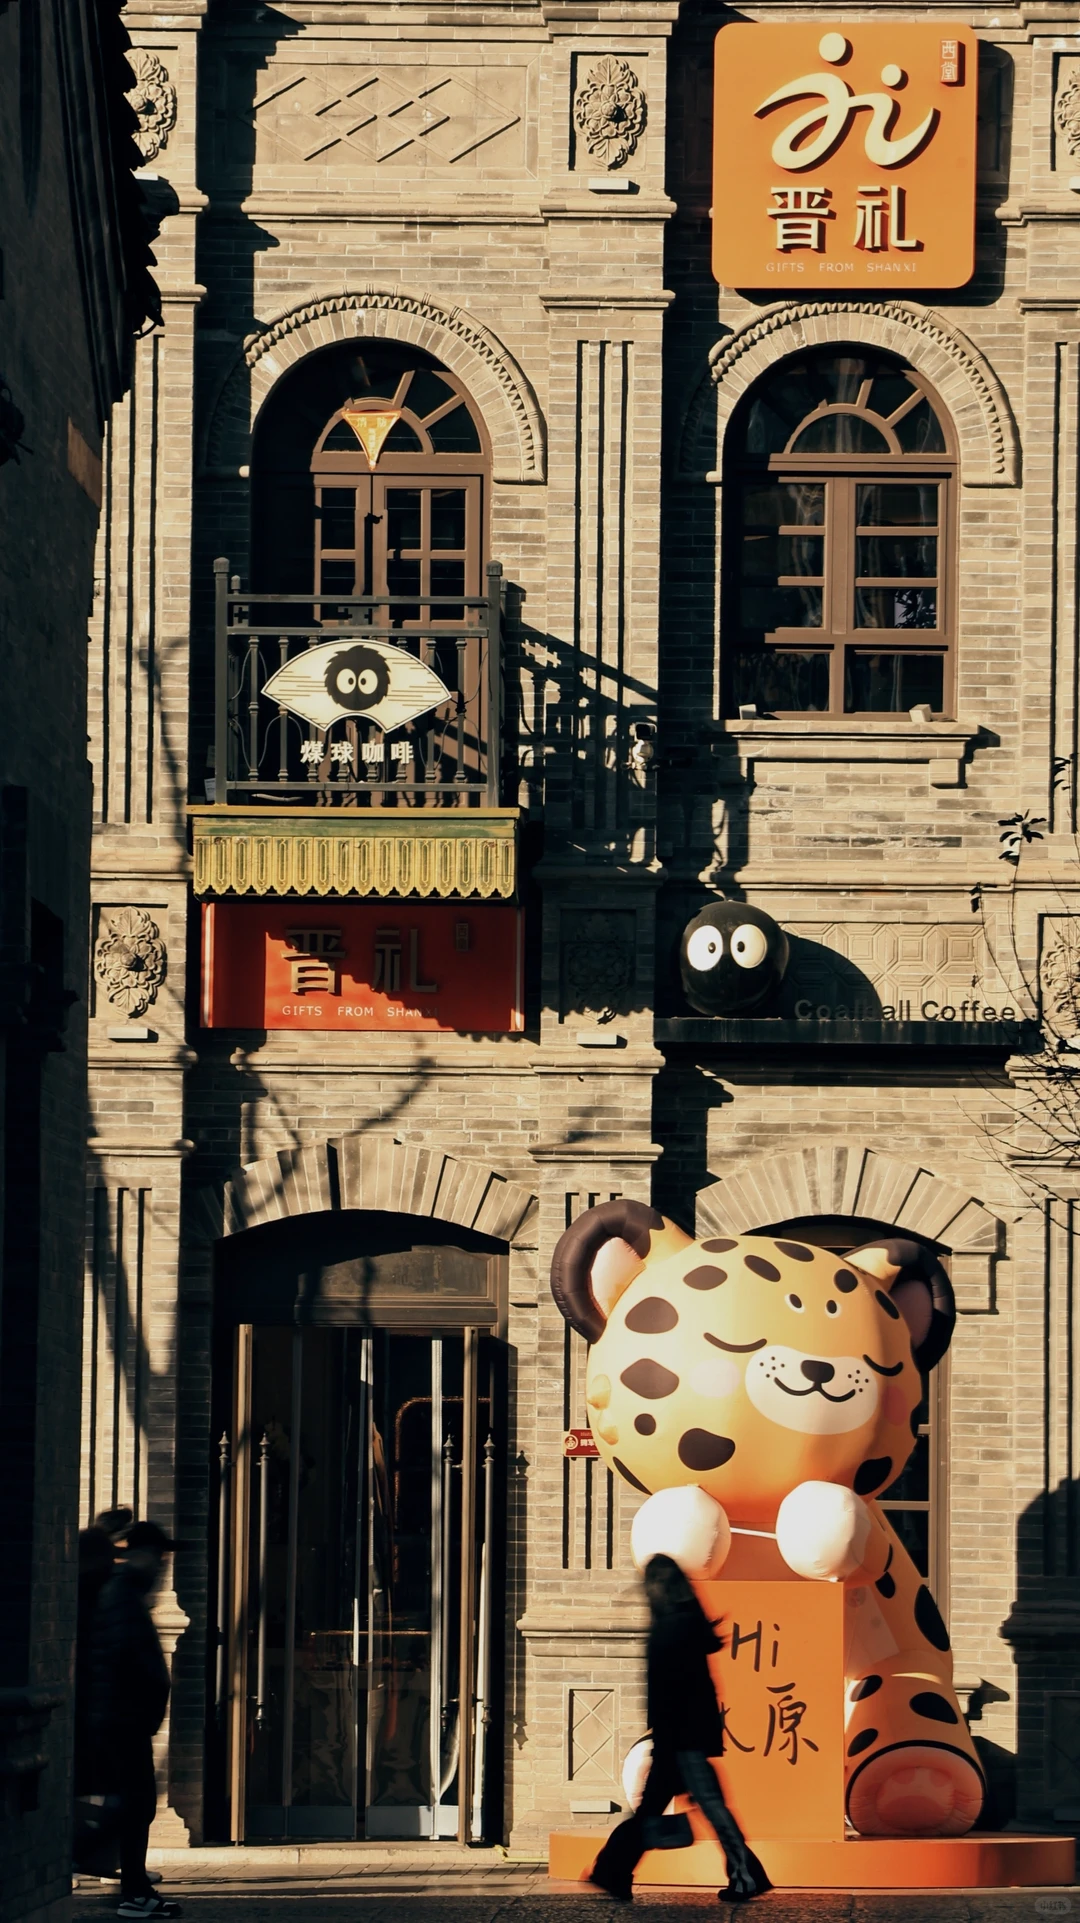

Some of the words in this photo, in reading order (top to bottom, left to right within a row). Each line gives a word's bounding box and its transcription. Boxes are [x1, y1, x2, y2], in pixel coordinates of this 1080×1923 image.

[766, 185, 917, 249] 晋礼
[766, 262, 805, 273] GIFTS
[819, 262, 854, 273] FROM
[866, 262, 917, 273] SHANXI
[300, 740, 414, 764] 煤球咖啡
[281, 929, 438, 994] 晋礼
[282, 1005, 323, 1017] GIFTS
[337, 1006, 374, 1017] FROM
[921, 999, 1016, 1022] Coffee
[731, 1620, 780, 1673] Hi
